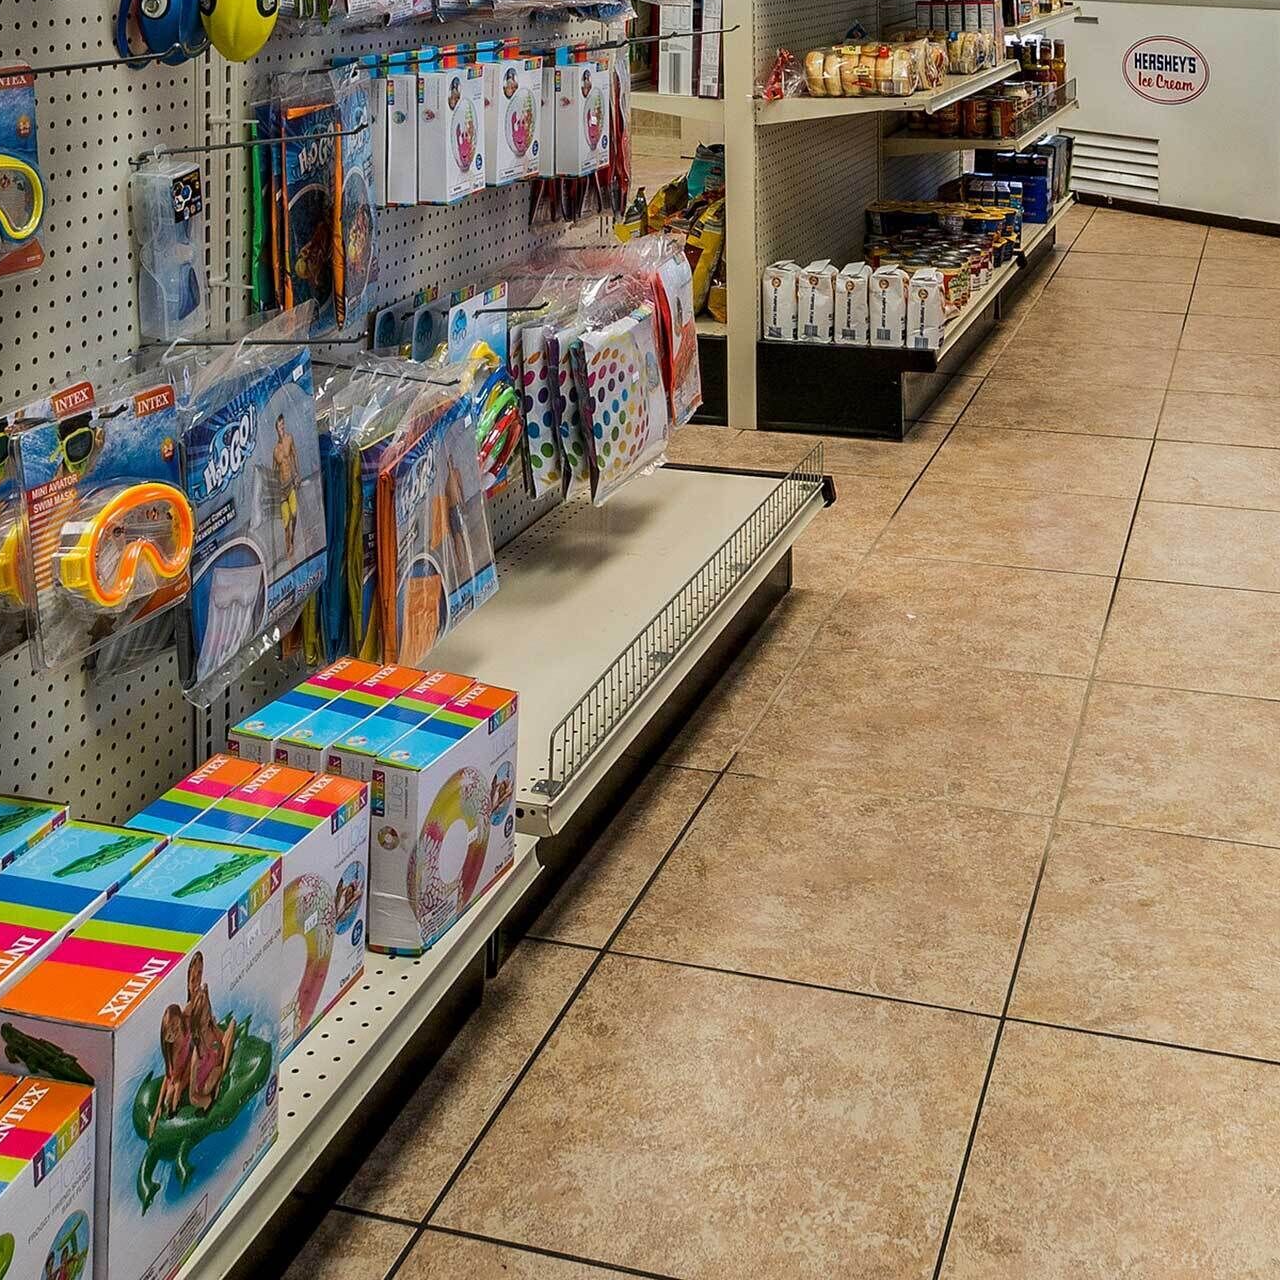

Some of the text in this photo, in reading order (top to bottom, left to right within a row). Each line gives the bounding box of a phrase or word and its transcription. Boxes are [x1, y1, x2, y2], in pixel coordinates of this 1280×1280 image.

[1134, 52, 1197, 74] HERSHEY'S
[1138, 71, 1195, 92] Ice Cream
[54, 387, 90, 412] INTEX
[137, 392, 170, 410] INTEX
[32, 473, 79, 499] MINI AVIATOR
[33, 490, 75, 513] SWIM MASK
[320, 659, 352, 681] INTEX
[365, 664, 397, 688] INTEX
[415, 671, 446, 695] INTEX
[454, 684, 487, 708] INTEX
[187, 756, 229, 785] INTEX
[241, 767, 283, 794] INTEX
[294, 776, 334, 804] INTEX
[375, 773, 385, 816] INTEX
[331, 790, 368, 834] INTEX
[229, 865, 282, 937] INTEX
[97, 956, 172, 1020] INTEX
[35, 1105, 92, 1182] INTEX
